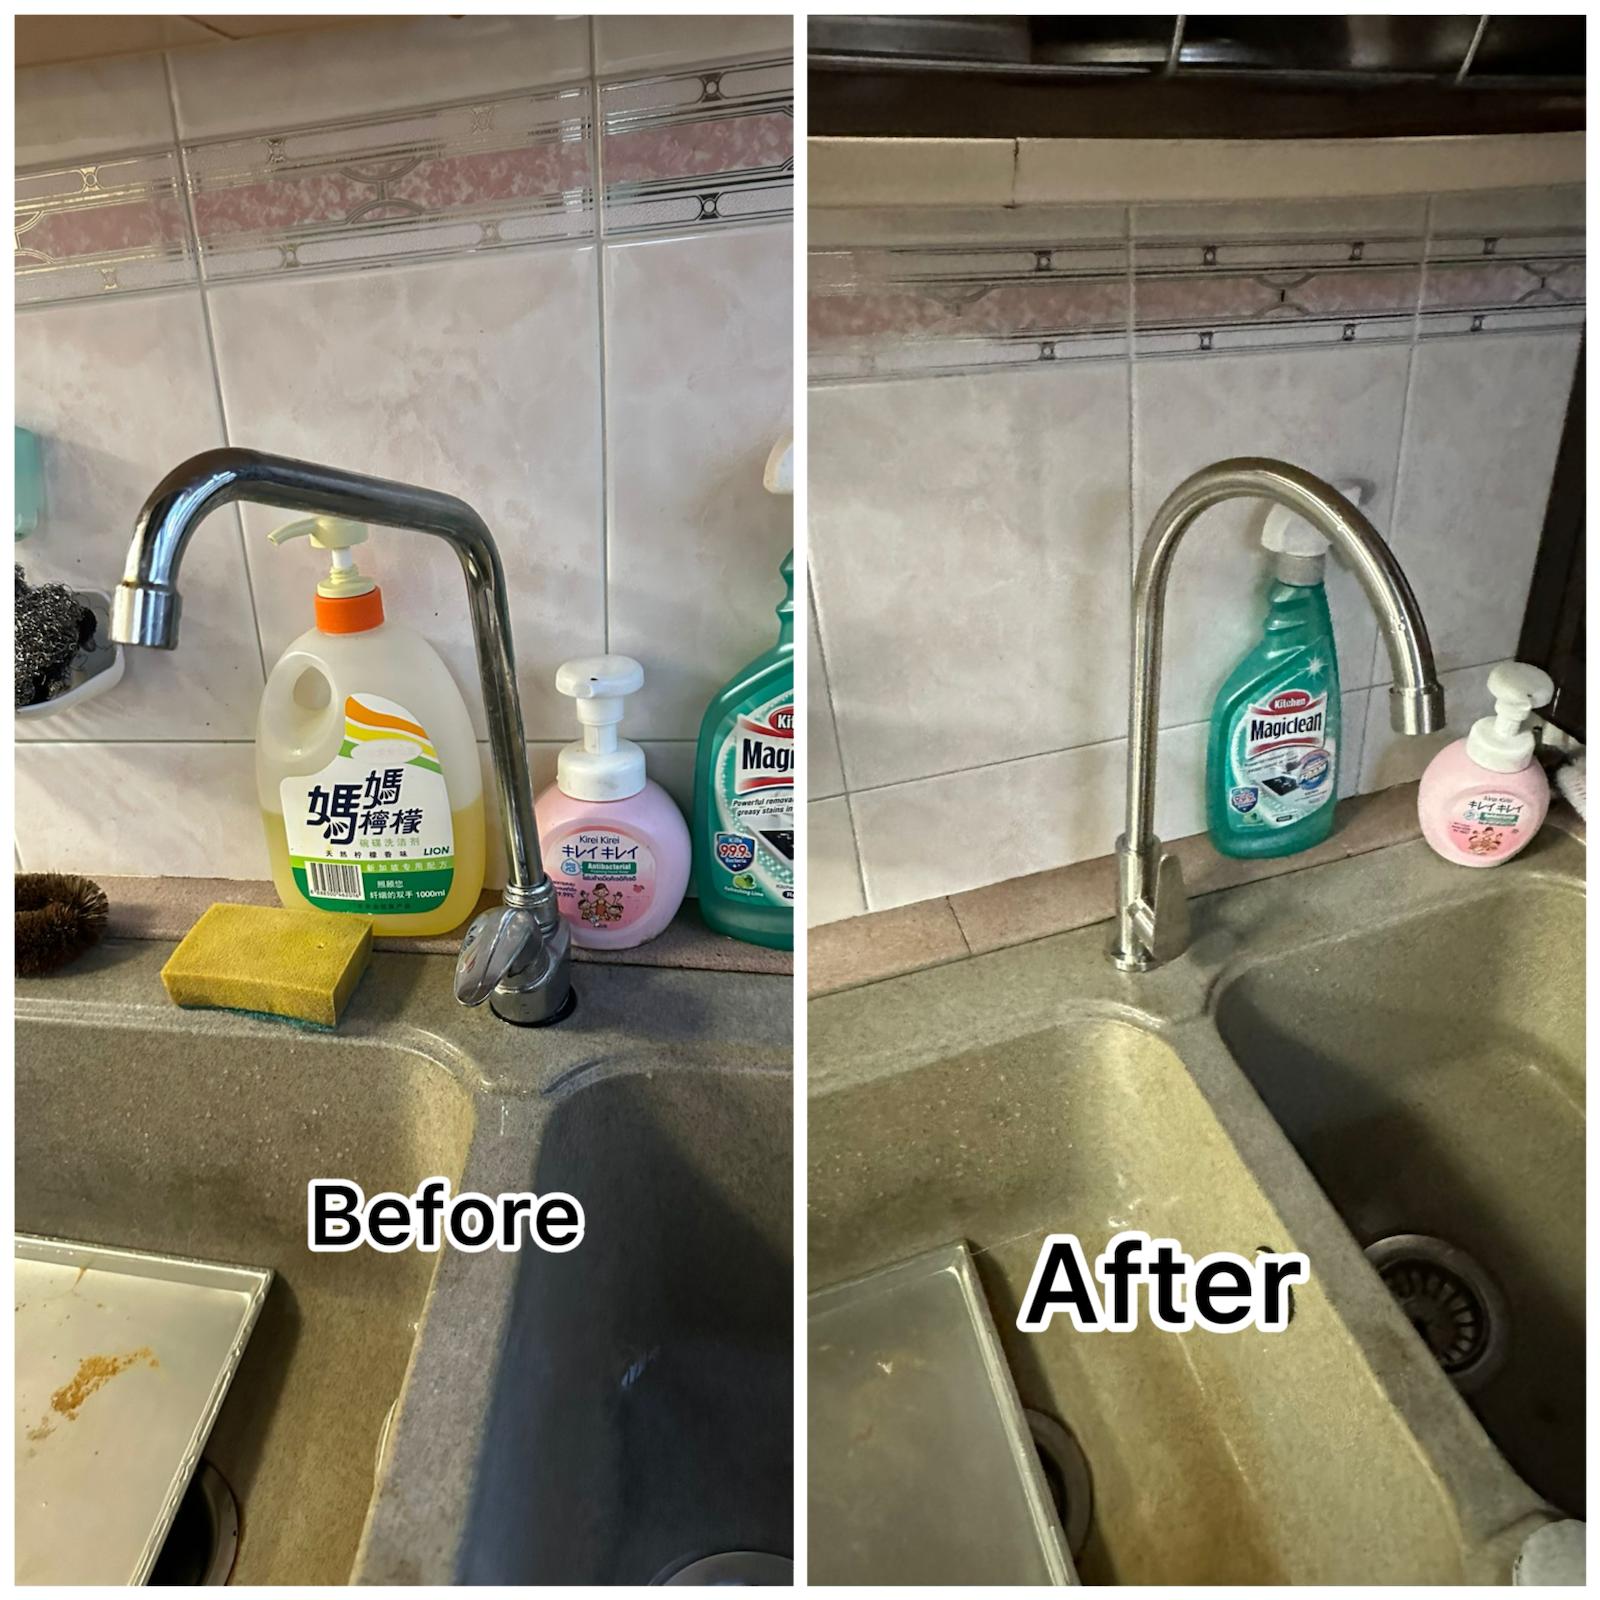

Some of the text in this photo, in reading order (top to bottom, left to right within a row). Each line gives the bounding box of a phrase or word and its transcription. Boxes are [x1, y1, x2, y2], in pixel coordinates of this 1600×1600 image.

[1274, 698, 1306, 709] Kitchen
[1250, 712, 1322, 742] Magiclean
[733, 798, 765, 807] Powerful
[1468, 800, 1524, 814] キレイ キレイ
[737, 808, 760, 817] greasy
[580, 835, 620, 845] Kirei Kirei
[423, 846, 450, 857] LION
[562, 844, 639, 860] キレイ キレイ
[587, 862, 632, 871] Antibacterial
[416, 889, 446, 899] 1000ml
